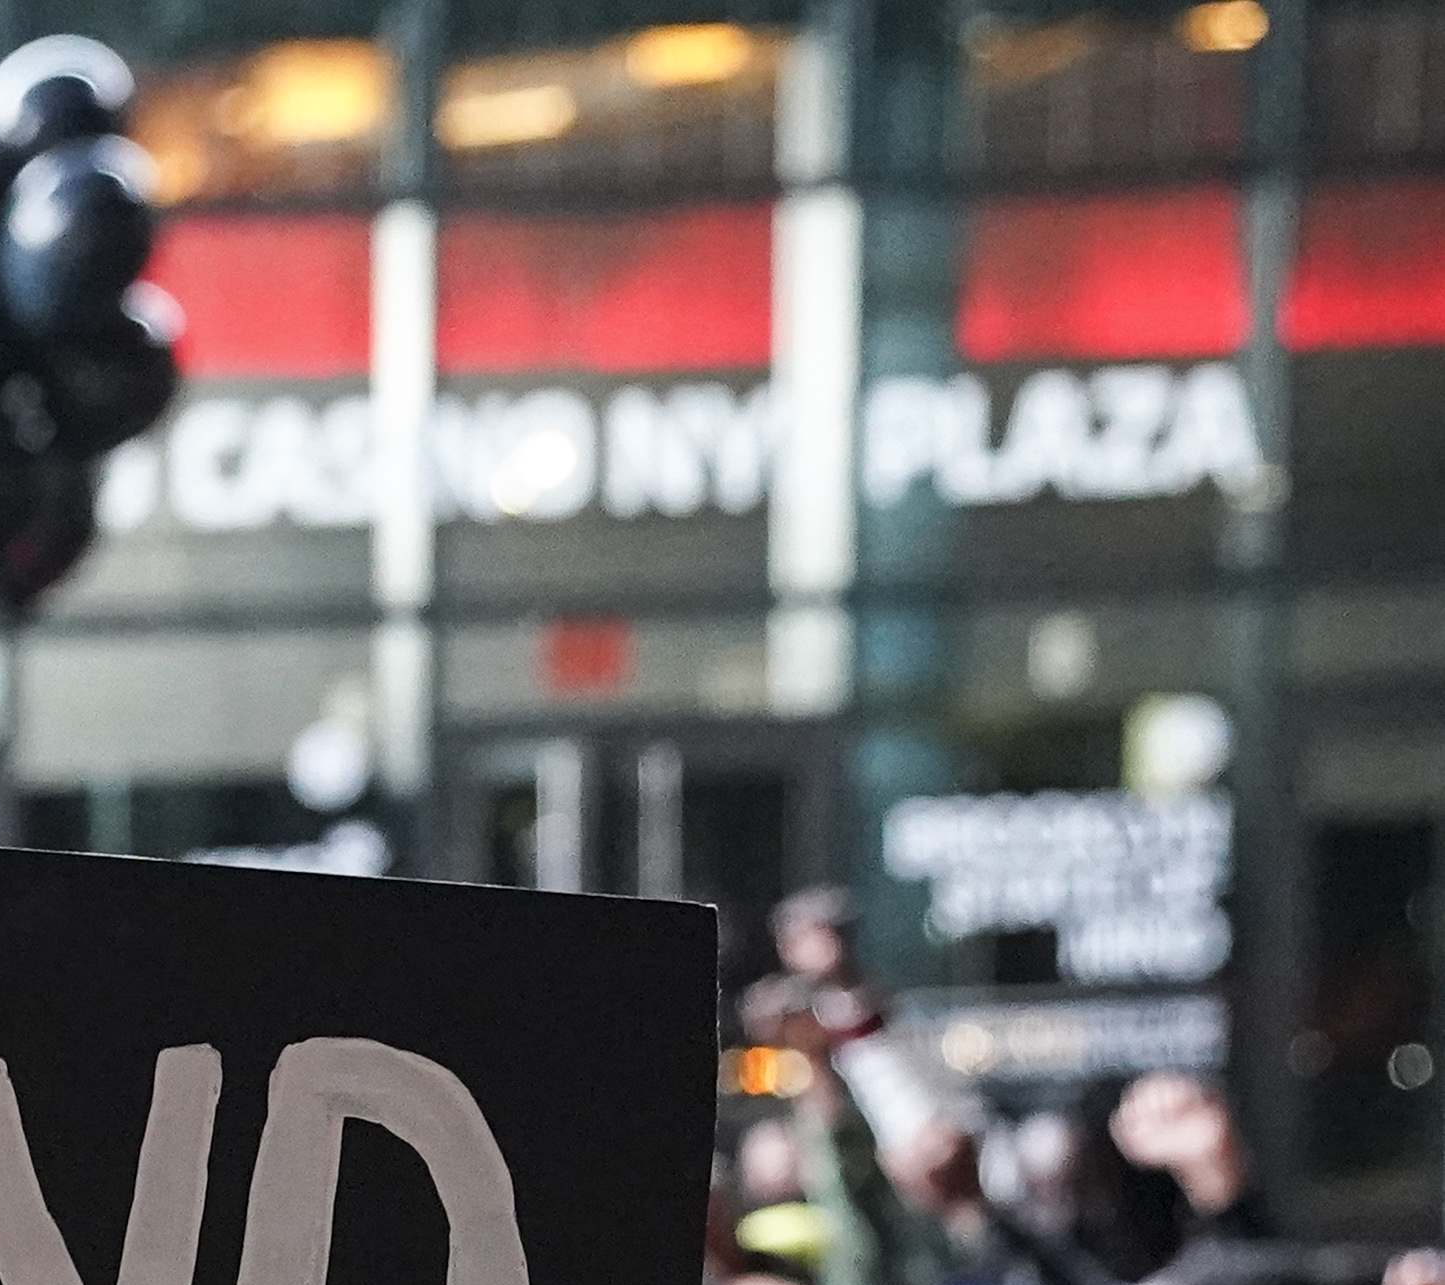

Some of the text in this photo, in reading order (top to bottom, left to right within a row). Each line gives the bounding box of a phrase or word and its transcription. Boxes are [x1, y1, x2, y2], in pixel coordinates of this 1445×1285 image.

[166, 392, 596, 526] CASNO
[604, 384, 799, 514] NY
[865, 365, 1258, 505] PLAZA
